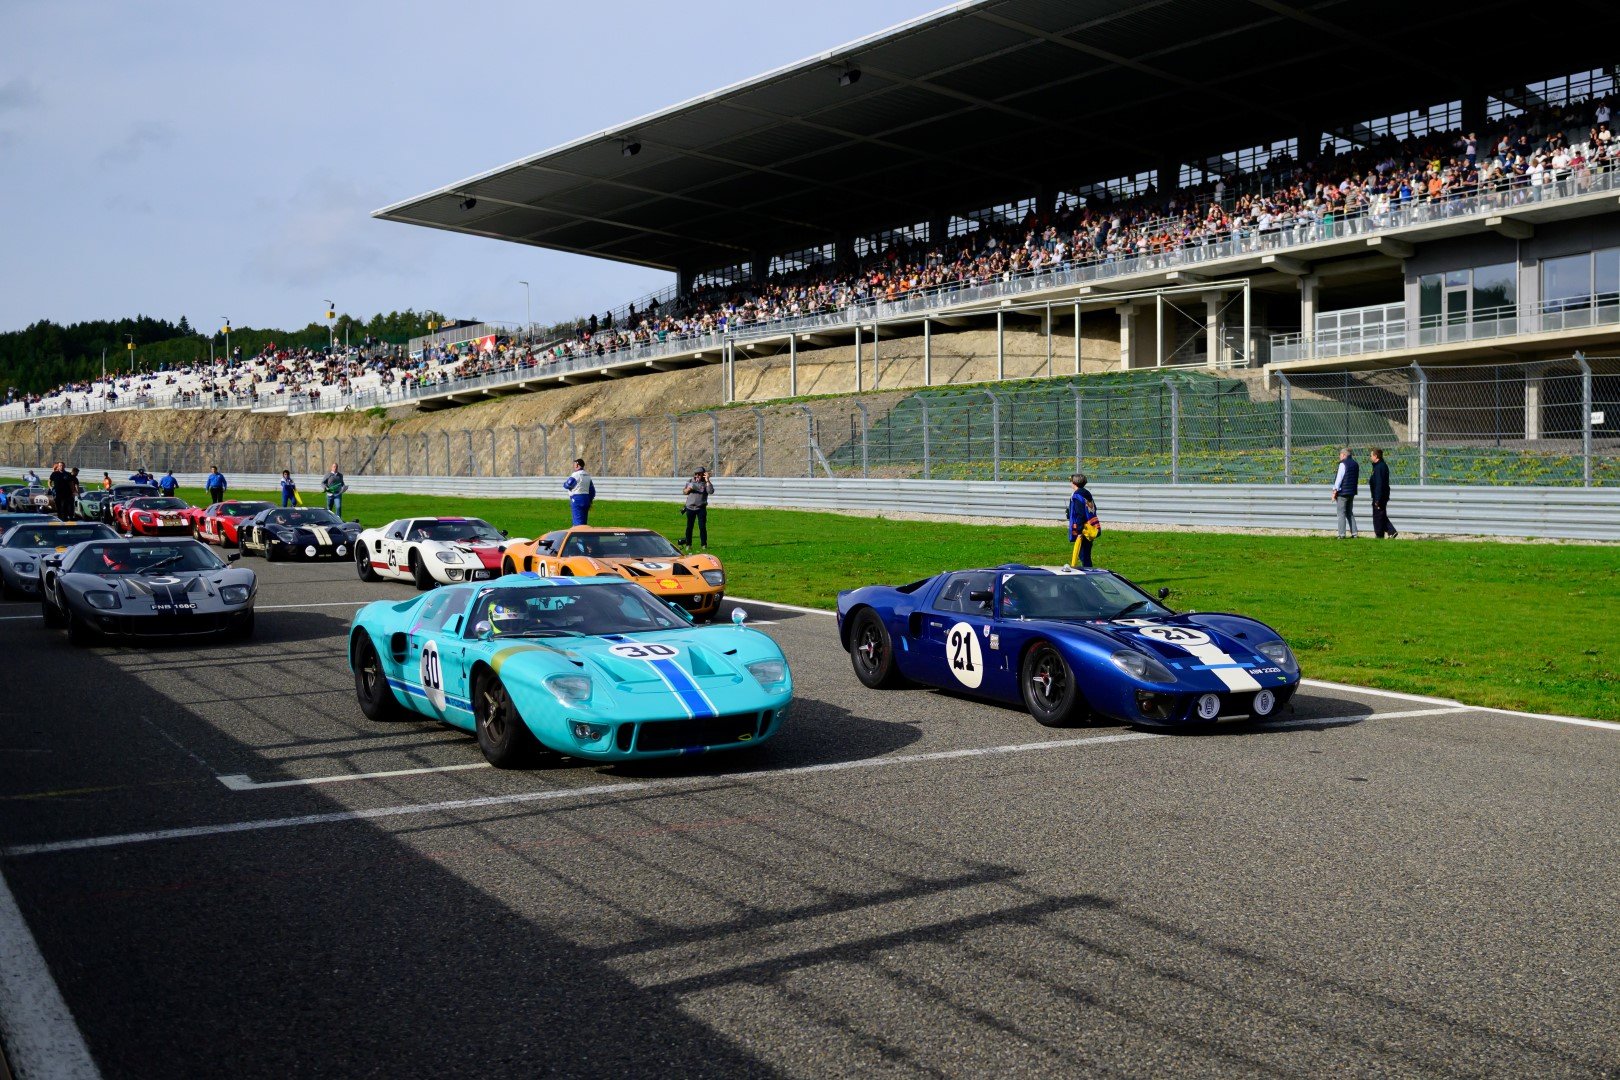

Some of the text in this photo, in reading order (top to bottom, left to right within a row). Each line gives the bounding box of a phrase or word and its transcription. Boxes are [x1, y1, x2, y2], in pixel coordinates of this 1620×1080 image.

[388, 549, 396, 567] 25
[1151, 628, 1201, 641] 21
[615, 645, 675, 657] 30
[952, 631, 975, 672] 21
[423, 648, 440, 689] 30
